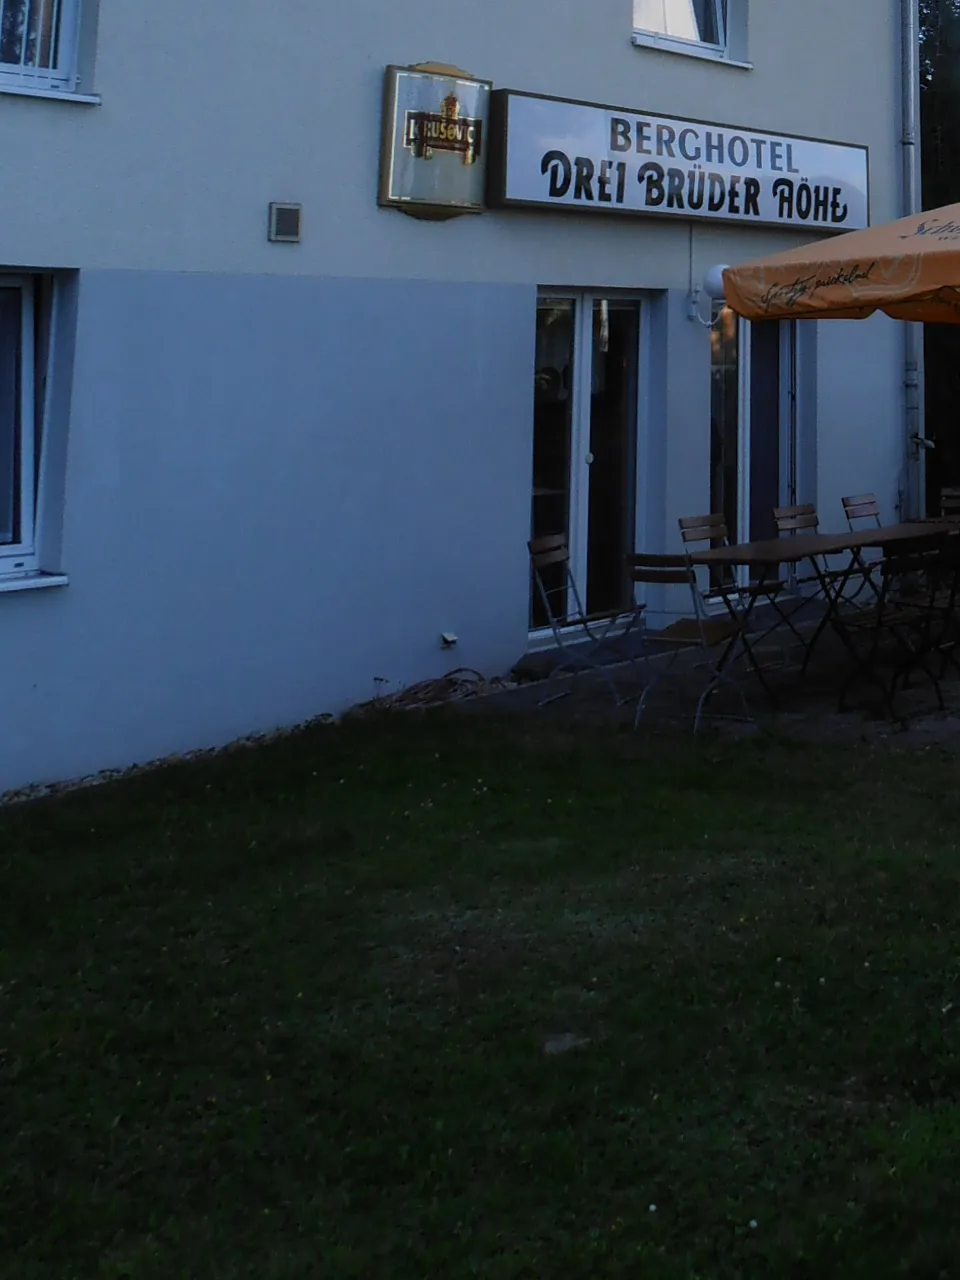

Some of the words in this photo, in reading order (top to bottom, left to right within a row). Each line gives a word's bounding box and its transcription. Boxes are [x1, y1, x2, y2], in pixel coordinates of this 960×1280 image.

[609, 117, 800, 174] BERGHOTEL
[540, 150, 626, 204] DREI
[637, 161, 761, 216] BRÜDER
